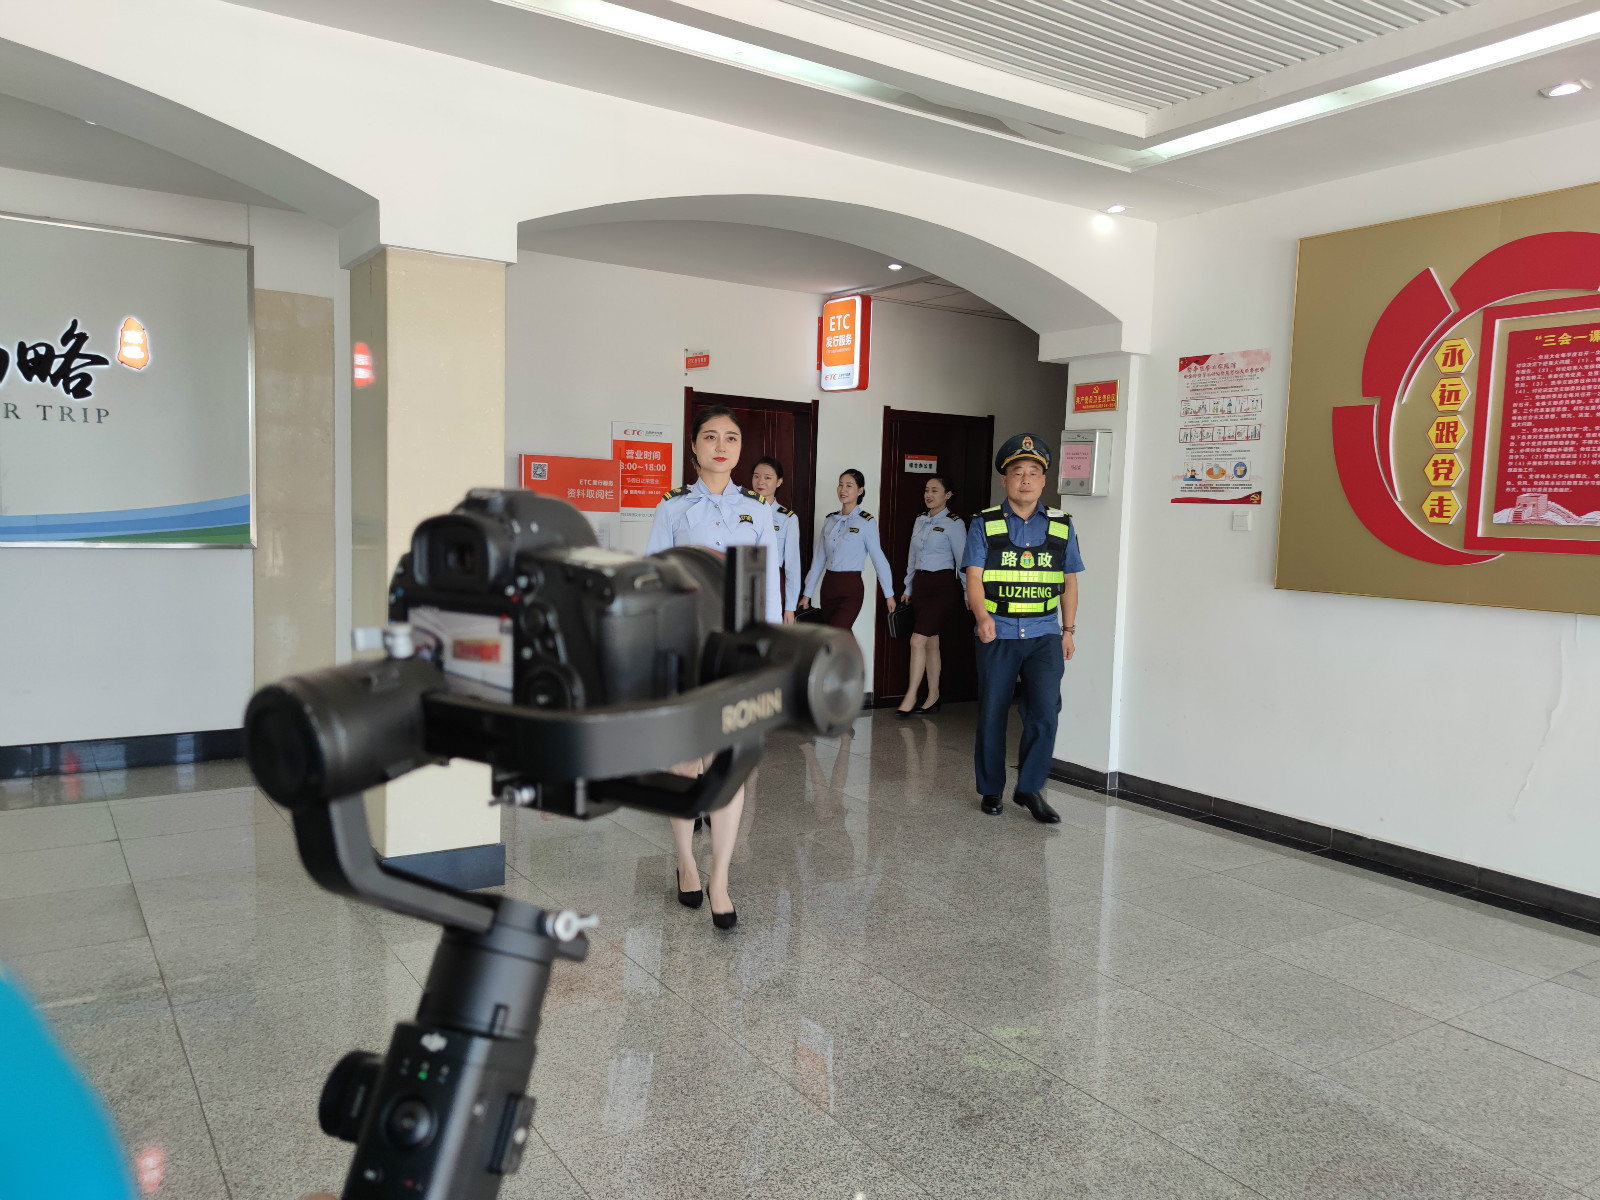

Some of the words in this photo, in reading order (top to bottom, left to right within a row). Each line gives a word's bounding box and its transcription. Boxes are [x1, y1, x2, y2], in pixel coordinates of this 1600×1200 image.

[829, 313, 851, 332] ETC
[825, 333, 852, 348] 发行服务
[0, 318, 110, 400] 略
[36, 404, 110, 424] TRIP
[623, 428, 644, 437] ETC
[1427, 344, 1465, 519] 永远跟党走
[625, 449, 661, 461] 营业时间
[567, 488, 615, 500] 资料取阅栏
[998, 585, 1052, 599] LUZHENG
[721, 687, 783, 735] RONIN
